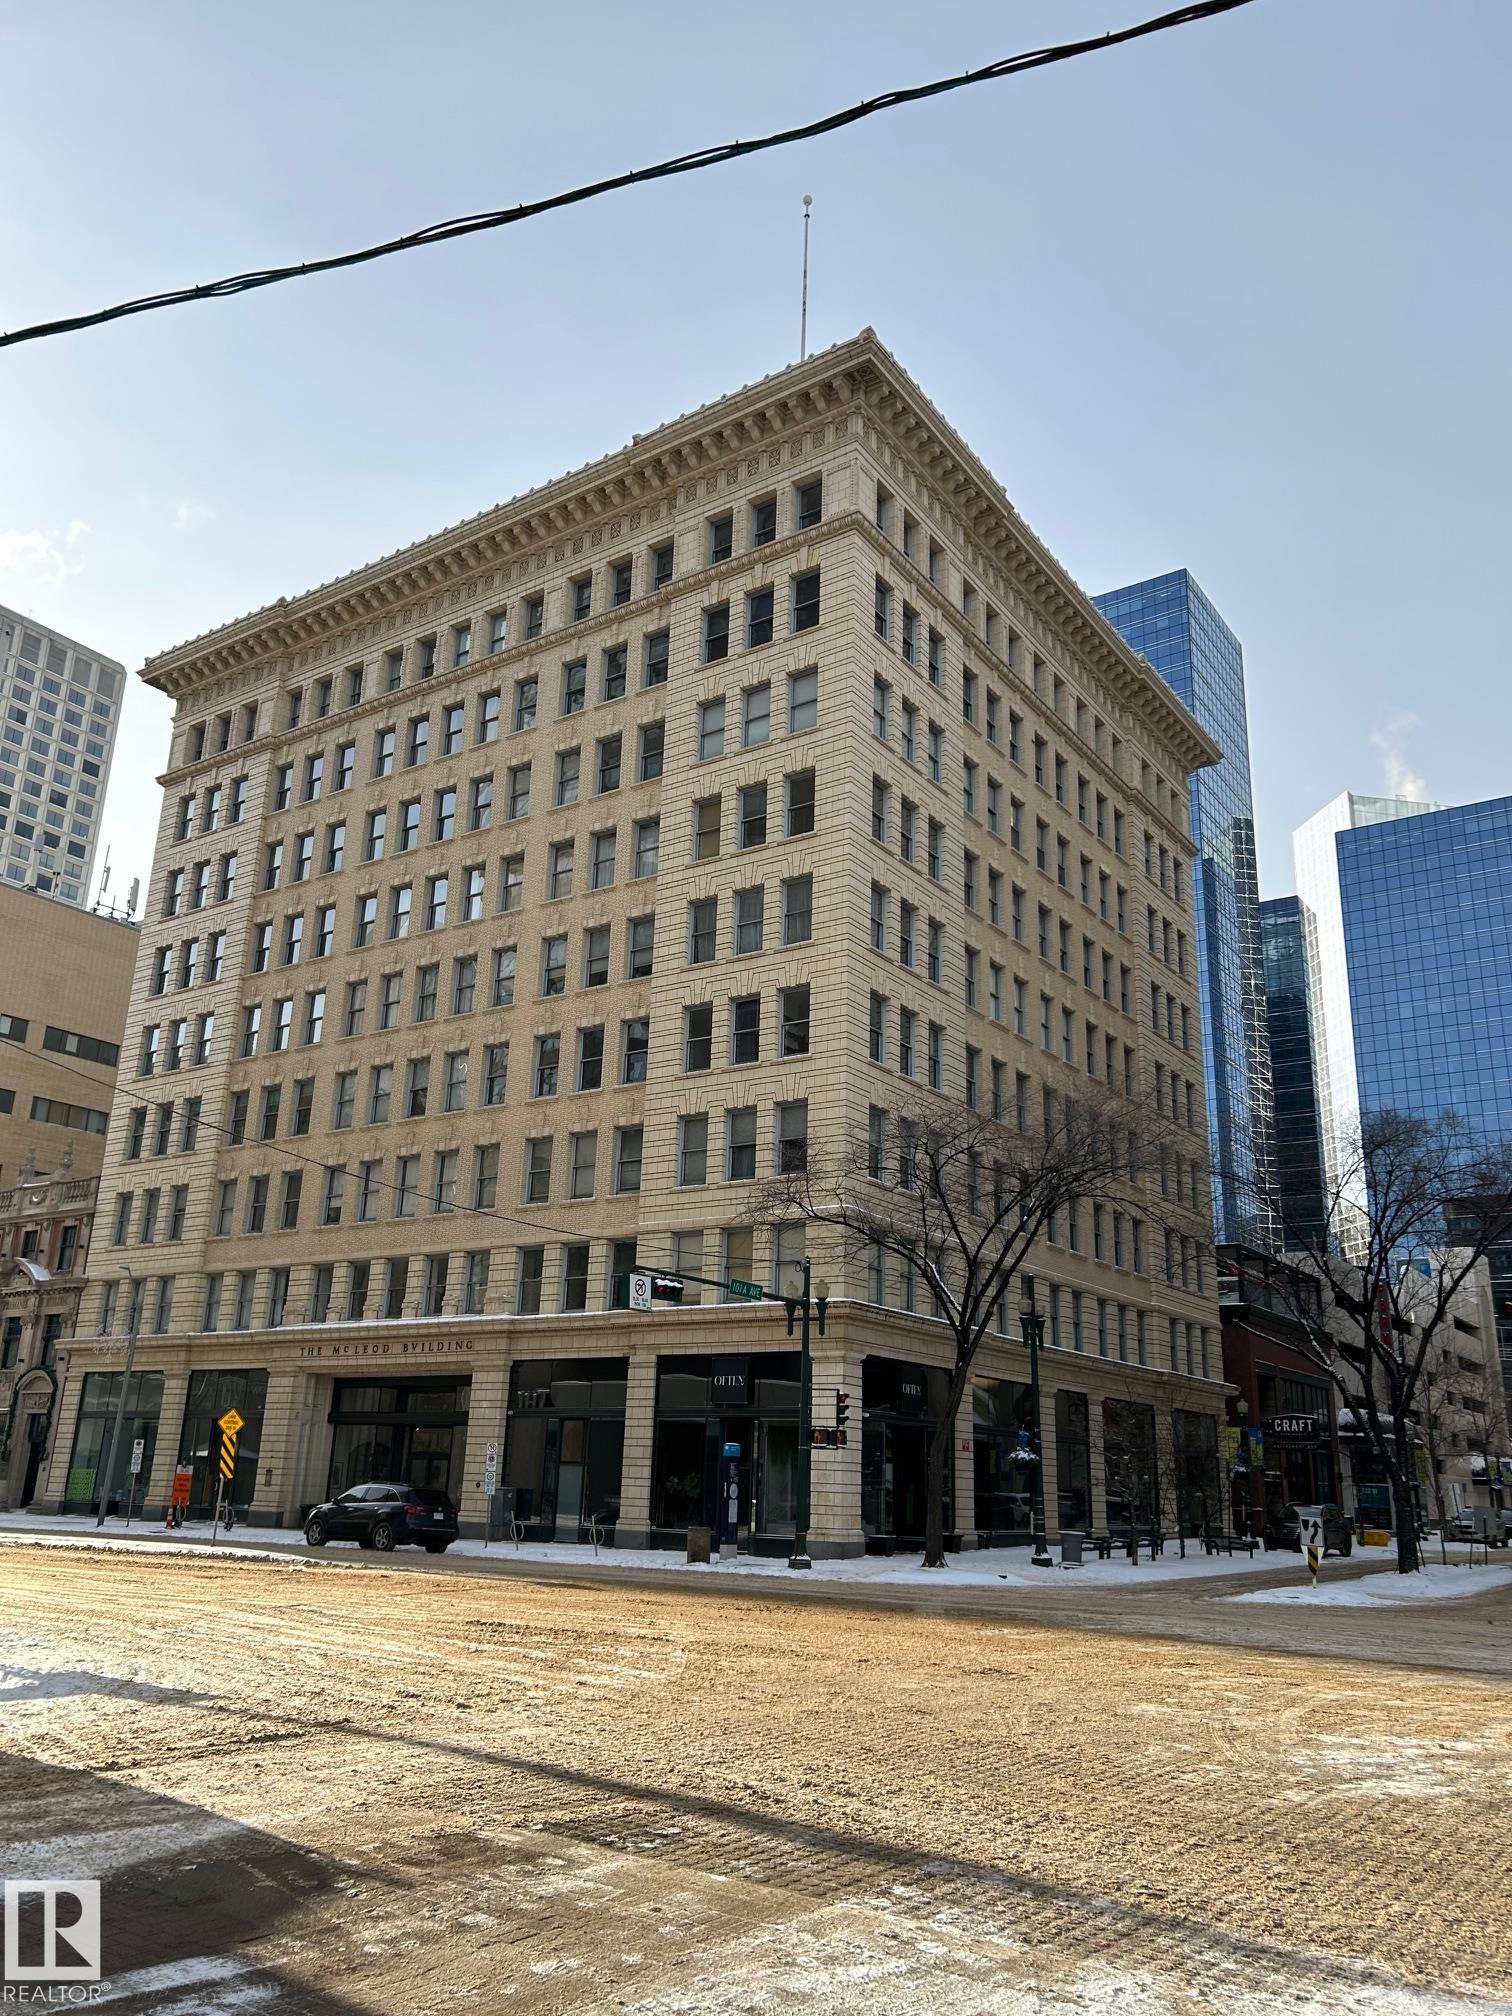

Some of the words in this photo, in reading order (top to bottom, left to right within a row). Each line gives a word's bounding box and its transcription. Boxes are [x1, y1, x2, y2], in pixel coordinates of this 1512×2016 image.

[732, 1282, 747, 1294] 101A
[749, 1286, 761, 1298] AVE
[300, 1347, 323, 1356] THE
[1274, 1419, 1313, 1432] CRAFT
